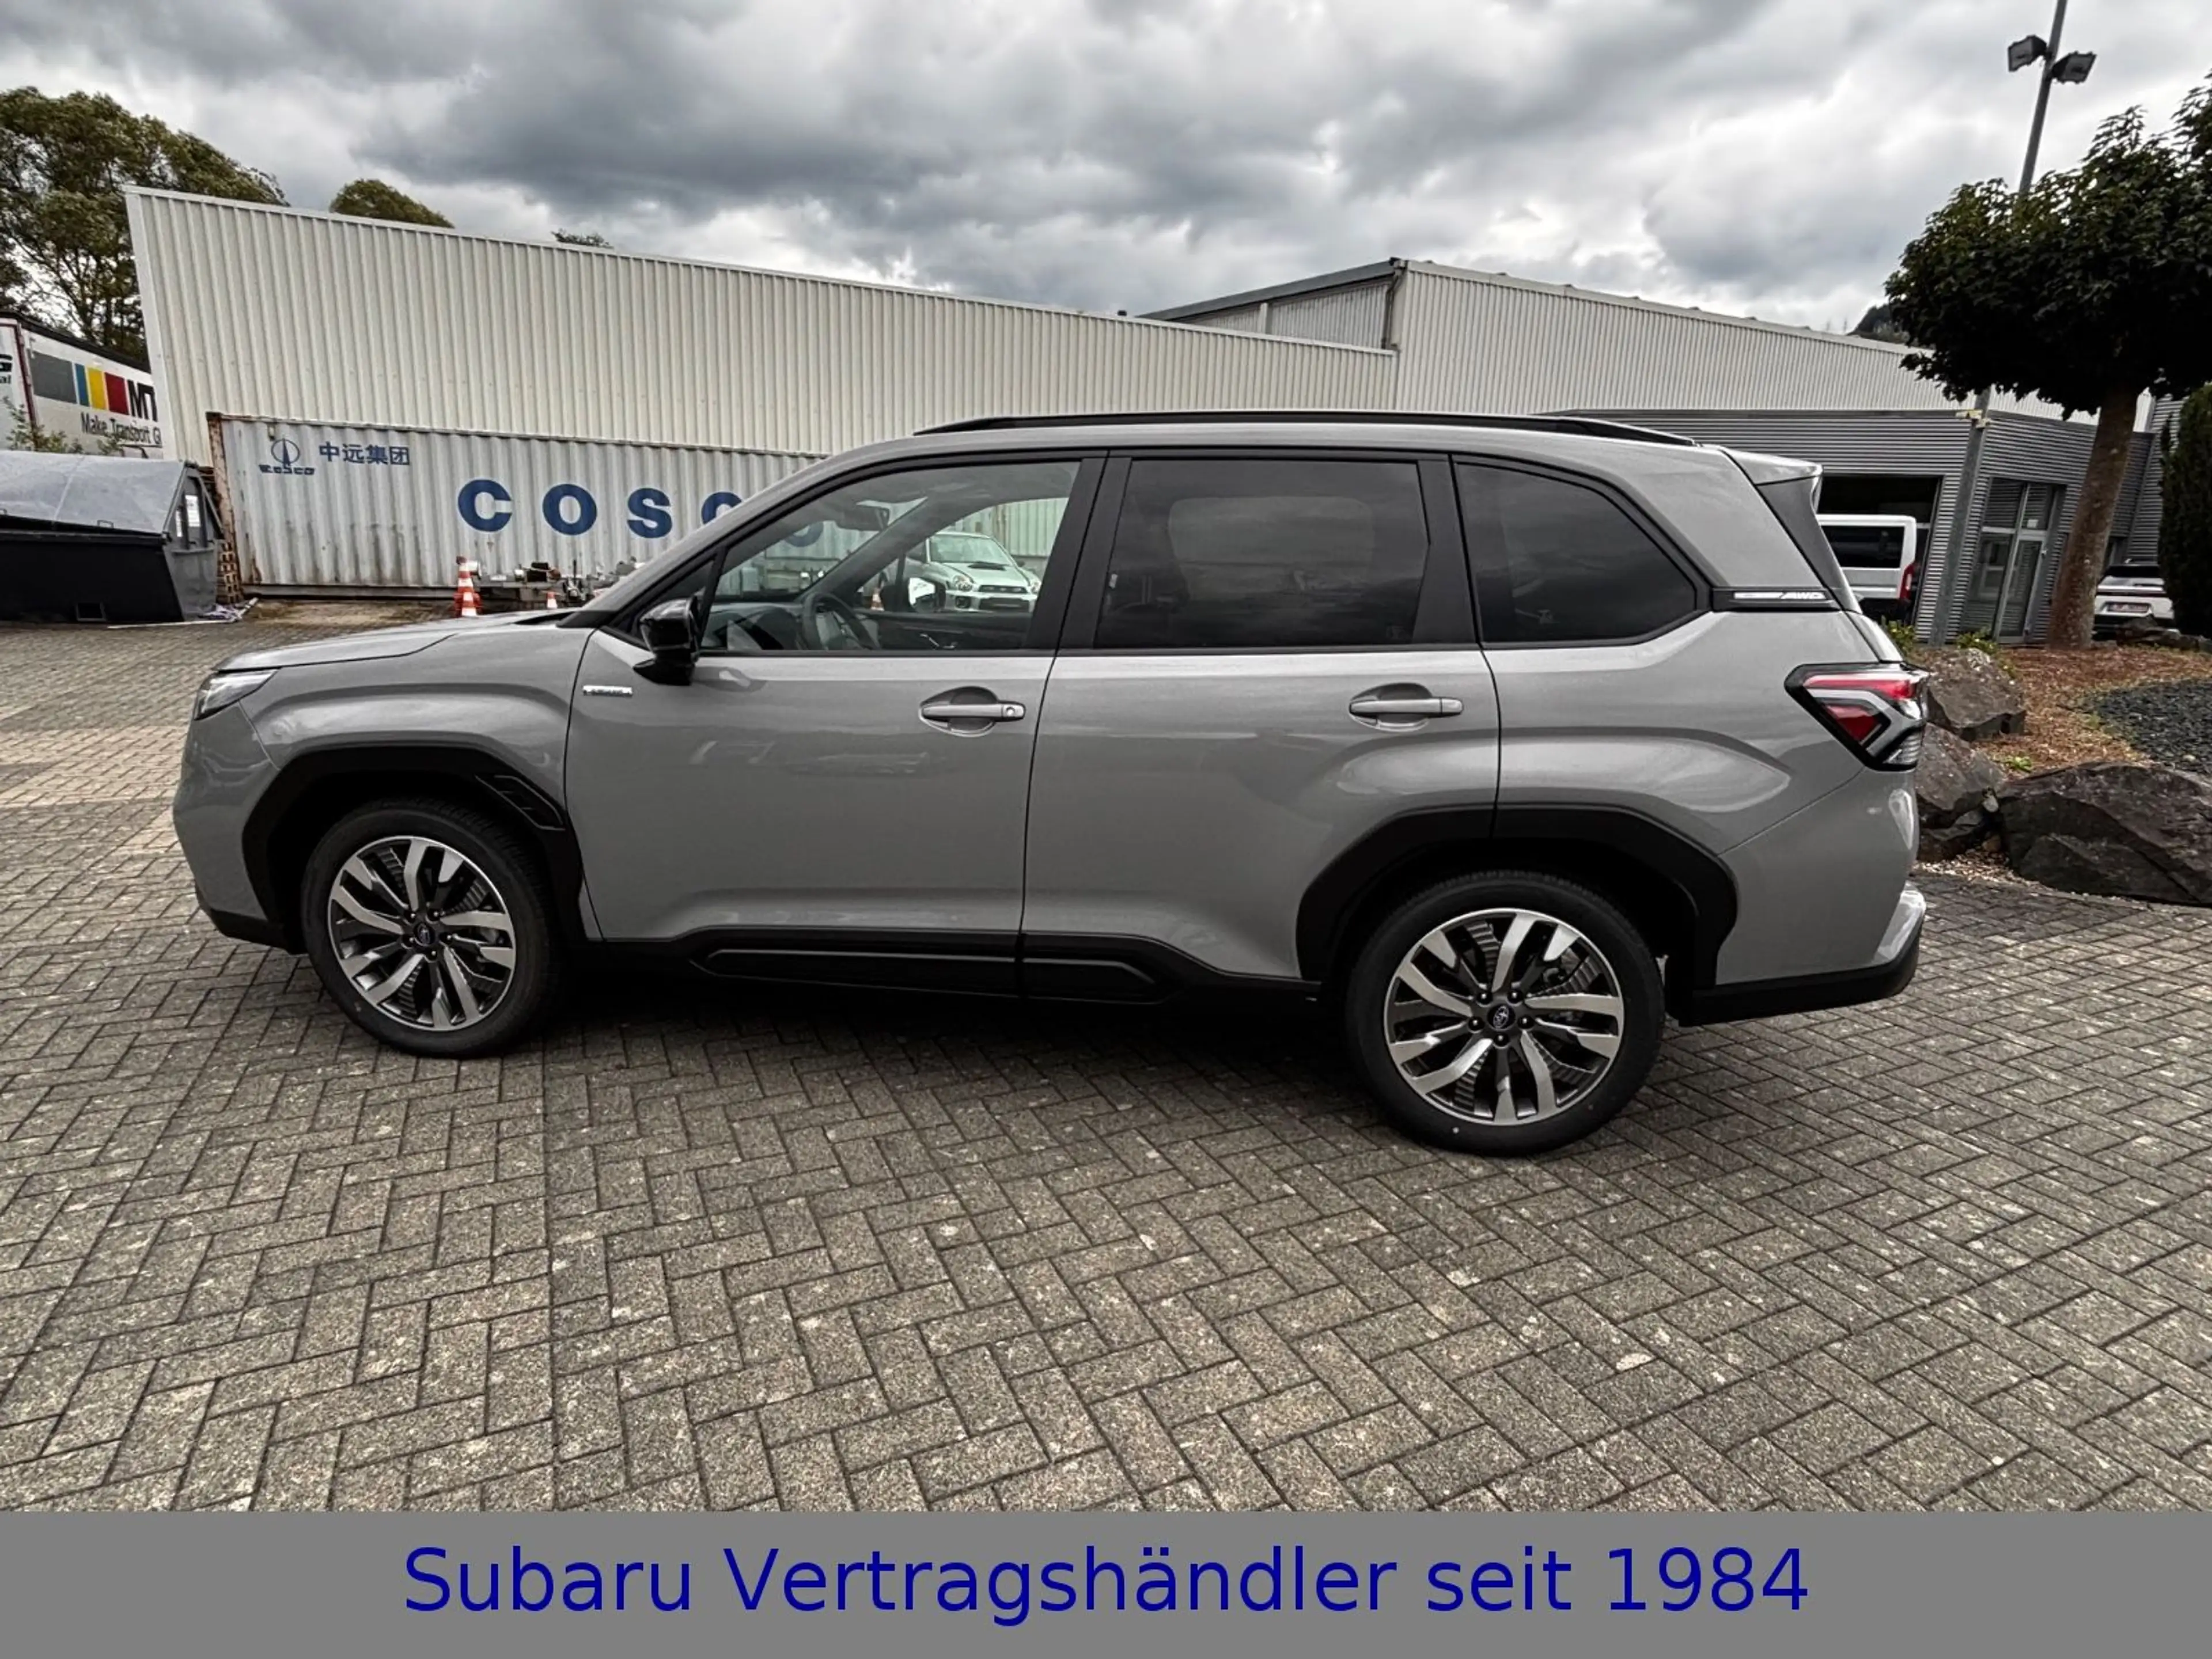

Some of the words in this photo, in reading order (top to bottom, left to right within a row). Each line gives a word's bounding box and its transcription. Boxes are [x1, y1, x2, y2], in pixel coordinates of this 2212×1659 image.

[81, 411, 108, 435] Make
[319, 441, 410, 465] 中远集团
